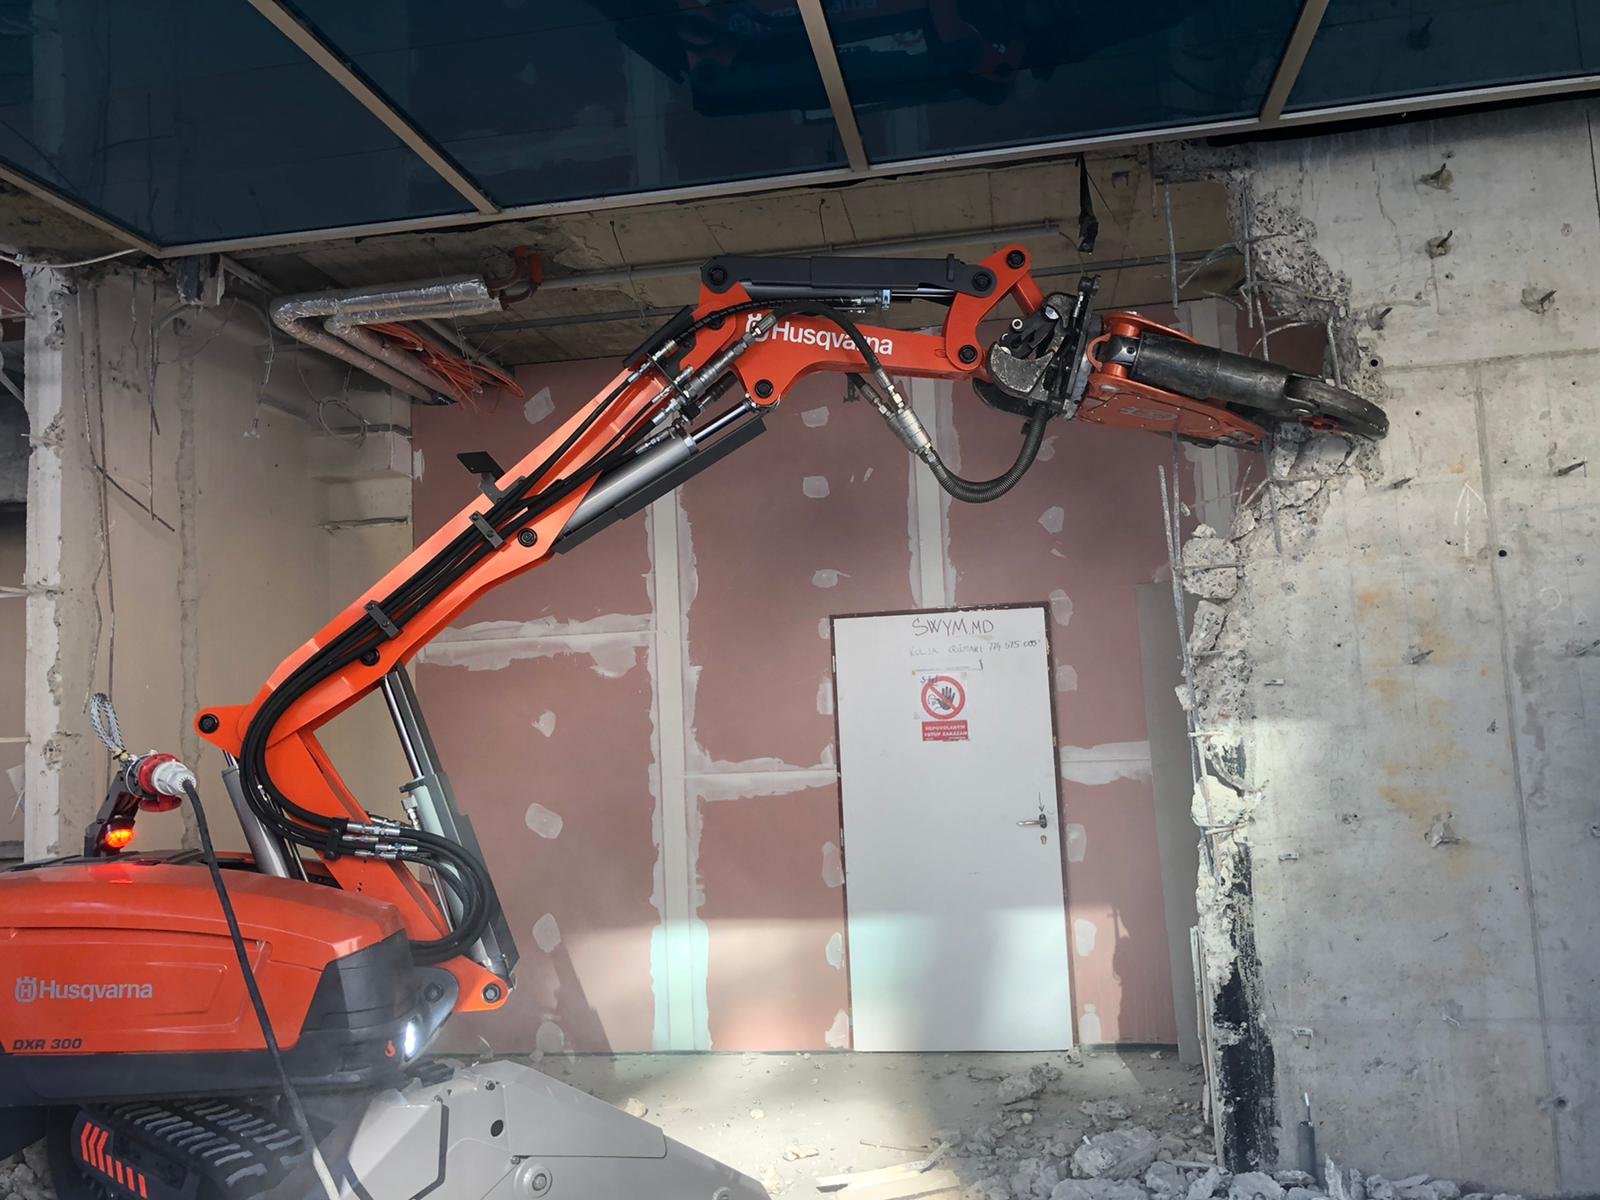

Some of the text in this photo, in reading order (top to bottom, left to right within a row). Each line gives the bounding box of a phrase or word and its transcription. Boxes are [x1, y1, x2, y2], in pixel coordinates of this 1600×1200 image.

[772, 321, 893, 355] Husqvana
[39, 979, 153, 1002] Husqvarna
[12, 1038, 82, 1050] DXR 300
